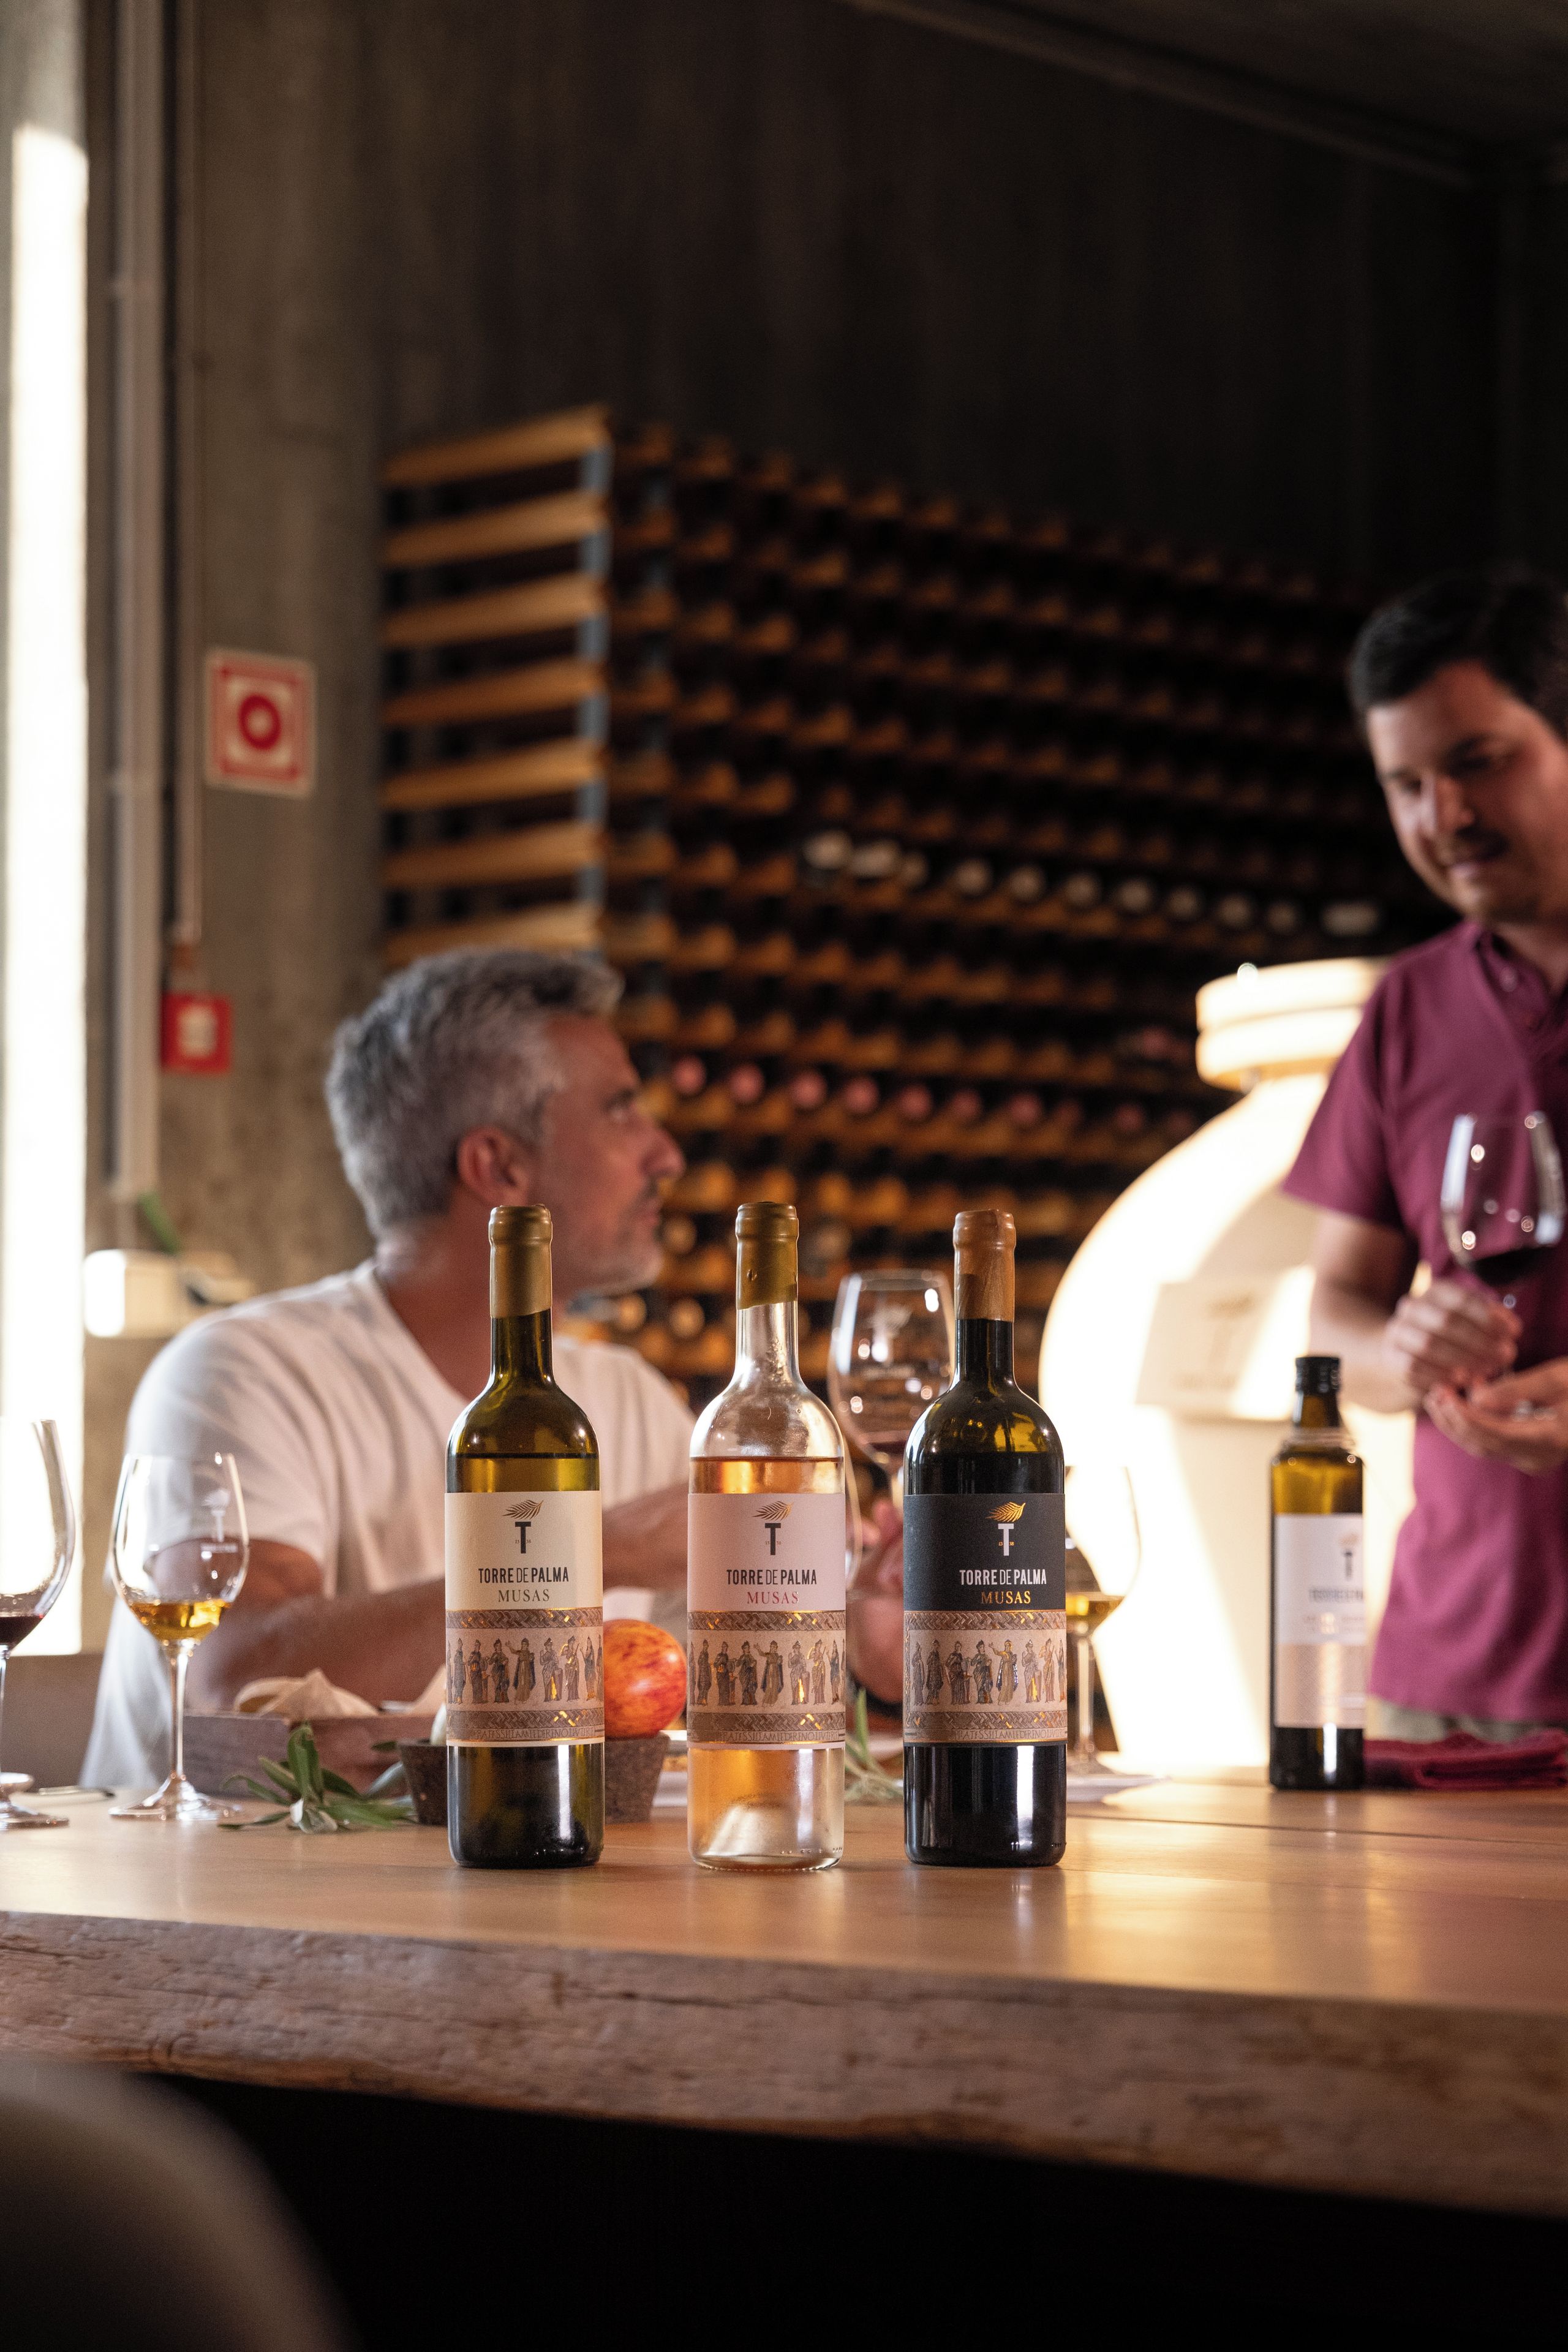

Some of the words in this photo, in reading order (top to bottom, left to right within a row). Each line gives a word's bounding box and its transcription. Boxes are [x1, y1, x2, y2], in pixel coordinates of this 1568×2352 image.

[515, 1521, 531, 1553] T
[765, 1523, 781, 1555] T
[998, 1523, 1014, 1556] T
[478, 1567, 514, 1583] TORRE
[516, 1567, 529, 1583] DE
[531, 1567, 569, 1583] PALMA
[726, 1569, 763, 1585] TORRE
[766, 1569, 778, 1585] DE
[780, 1569, 816, 1585] PALMA
[959, 1569, 998, 1585] TORRE
[1000, 1569, 1012, 1585] DE
[1014, 1569, 1047, 1585] PALMA
[498, 1589, 549, 1602] MUSAS
[747, 1591, 799, 1604] MUSAS
[981, 1590, 1031, 1604] MUSAS
